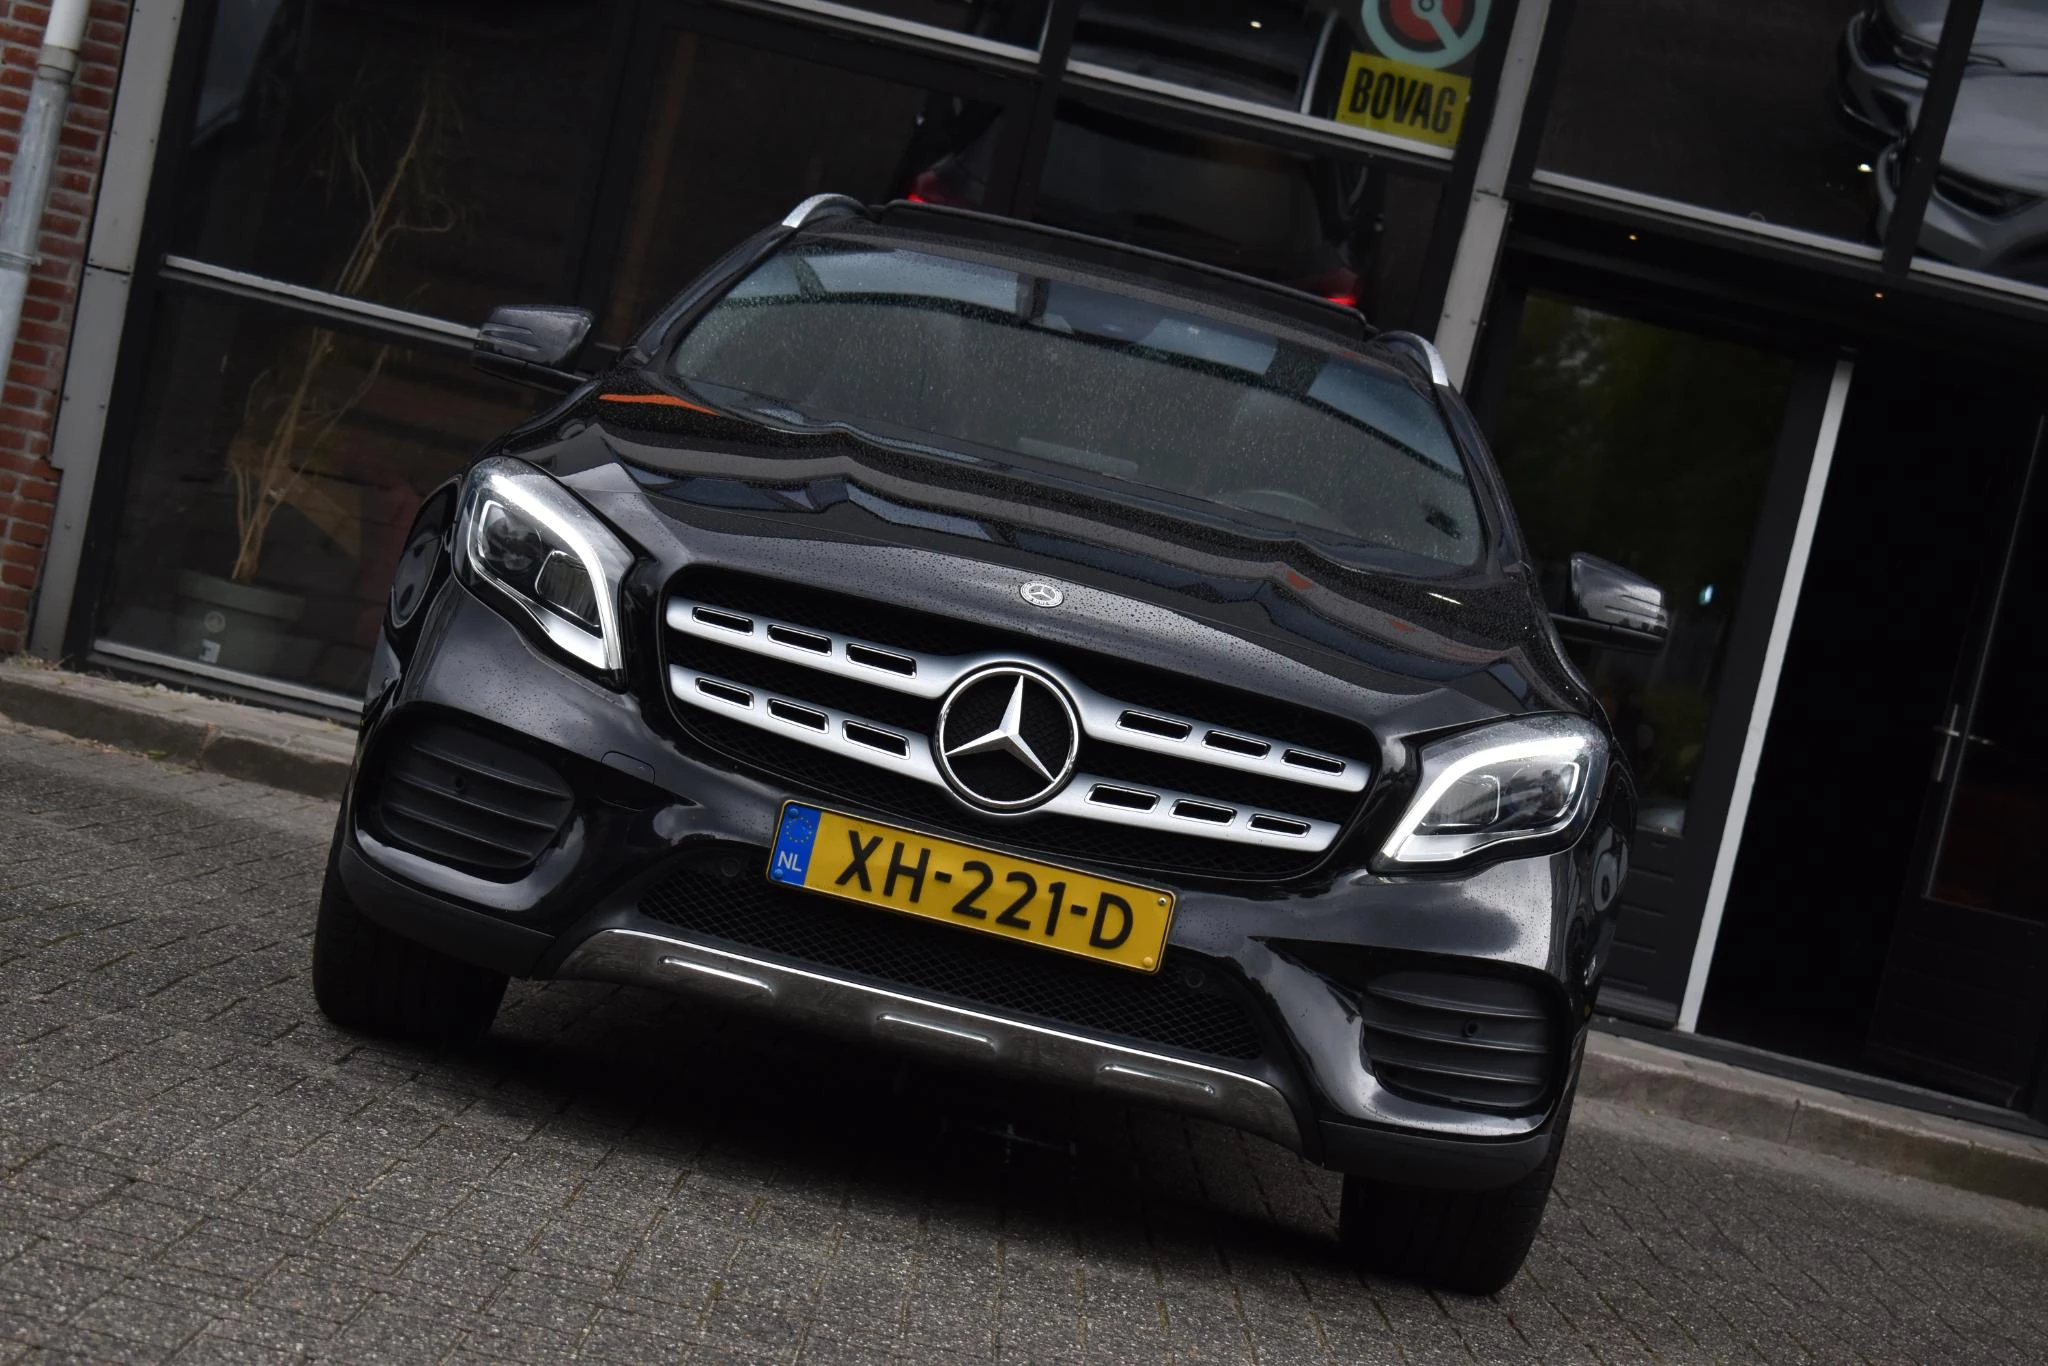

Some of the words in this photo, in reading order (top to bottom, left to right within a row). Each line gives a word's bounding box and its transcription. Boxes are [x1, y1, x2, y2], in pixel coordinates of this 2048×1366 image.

[1349, 67, 1457, 133] BOVAG
[778, 850, 802, 872] NL
[835, 829, 1134, 949] XH-221-D
